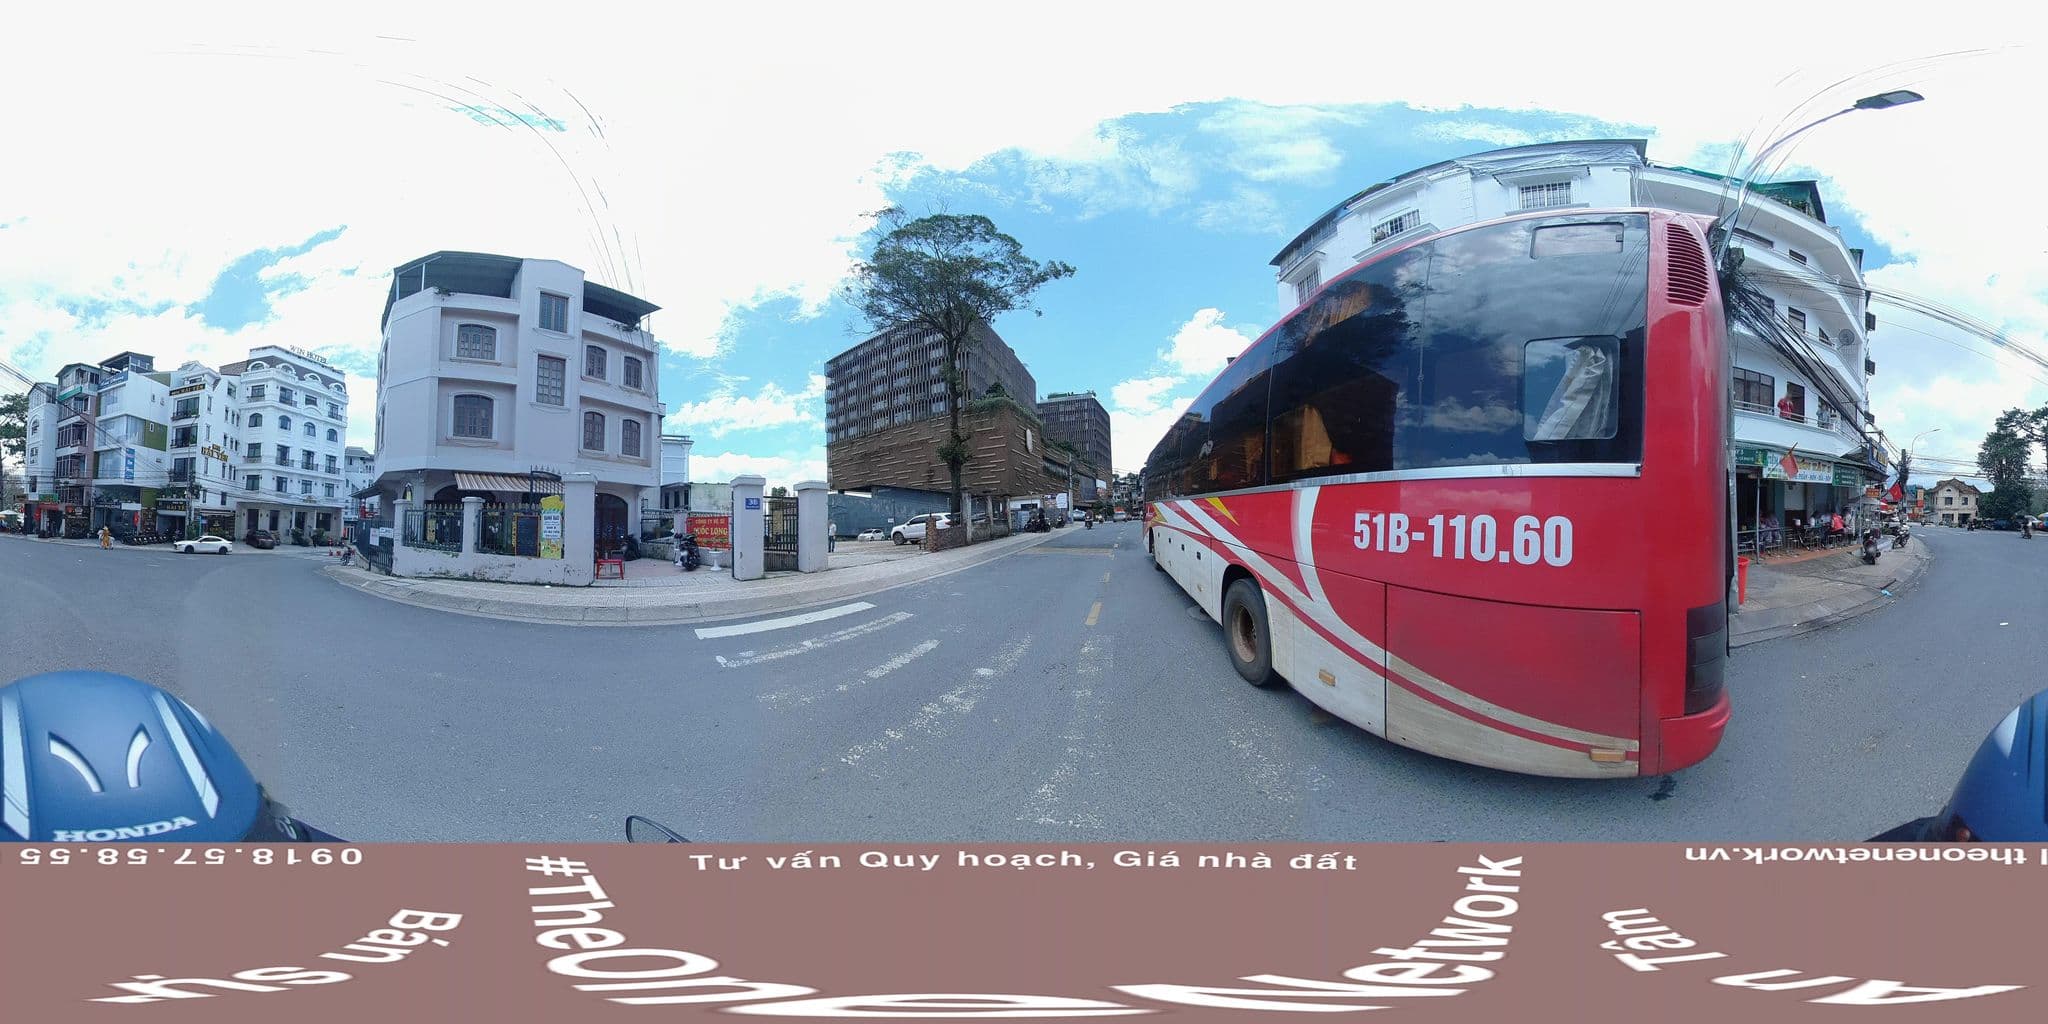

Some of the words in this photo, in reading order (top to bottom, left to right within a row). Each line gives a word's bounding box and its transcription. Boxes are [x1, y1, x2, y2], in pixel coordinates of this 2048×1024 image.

[306, 350, 328, 364] HOTEL
[1354, 512, 1573, 567] 51B-110.60
[53, 816, 197, 842] HONDA
